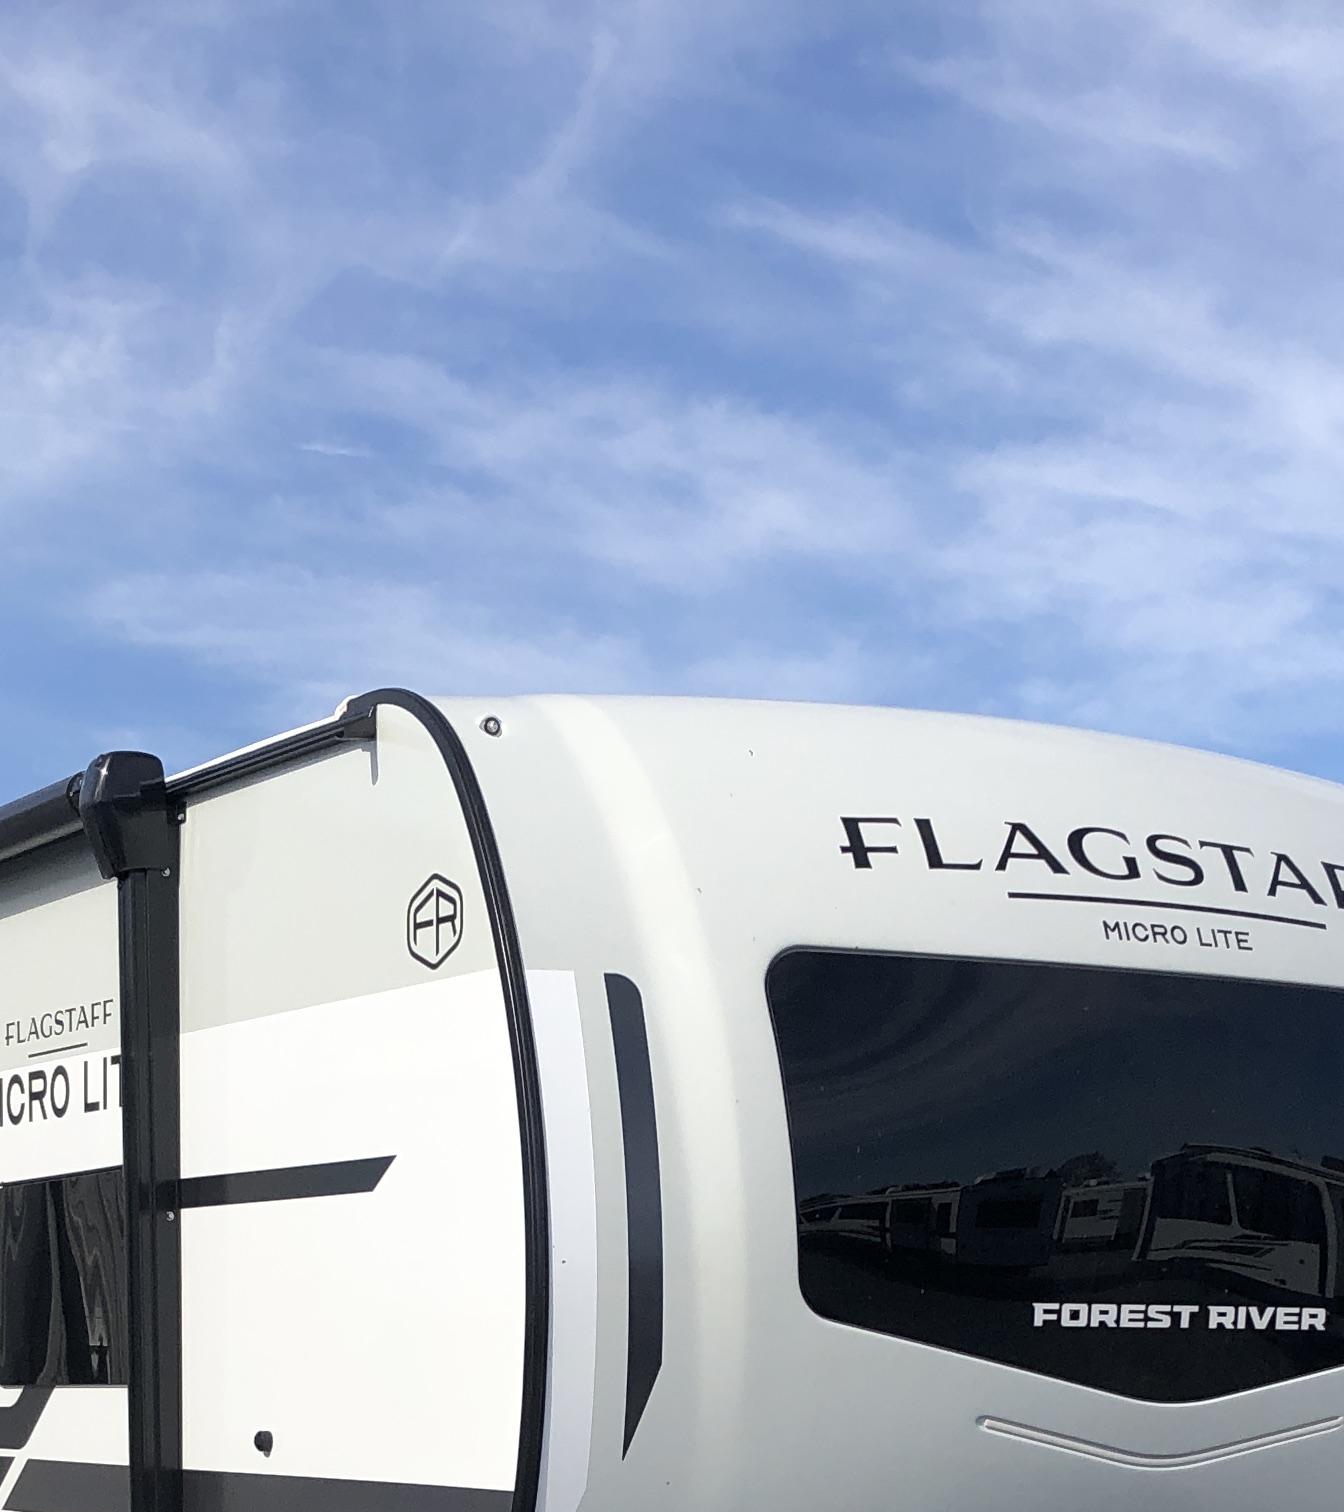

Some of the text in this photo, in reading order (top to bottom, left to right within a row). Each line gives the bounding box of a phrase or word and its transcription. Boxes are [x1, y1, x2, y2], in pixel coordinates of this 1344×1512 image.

[1102, 920, 1254, 951] MICRO LITE
[5, 999, 114, 1047] FLAGSTAFF
[83, 1054, 123, 1114] LIT
[1032, 1303, 1327, 1331] FOREST RIVER
